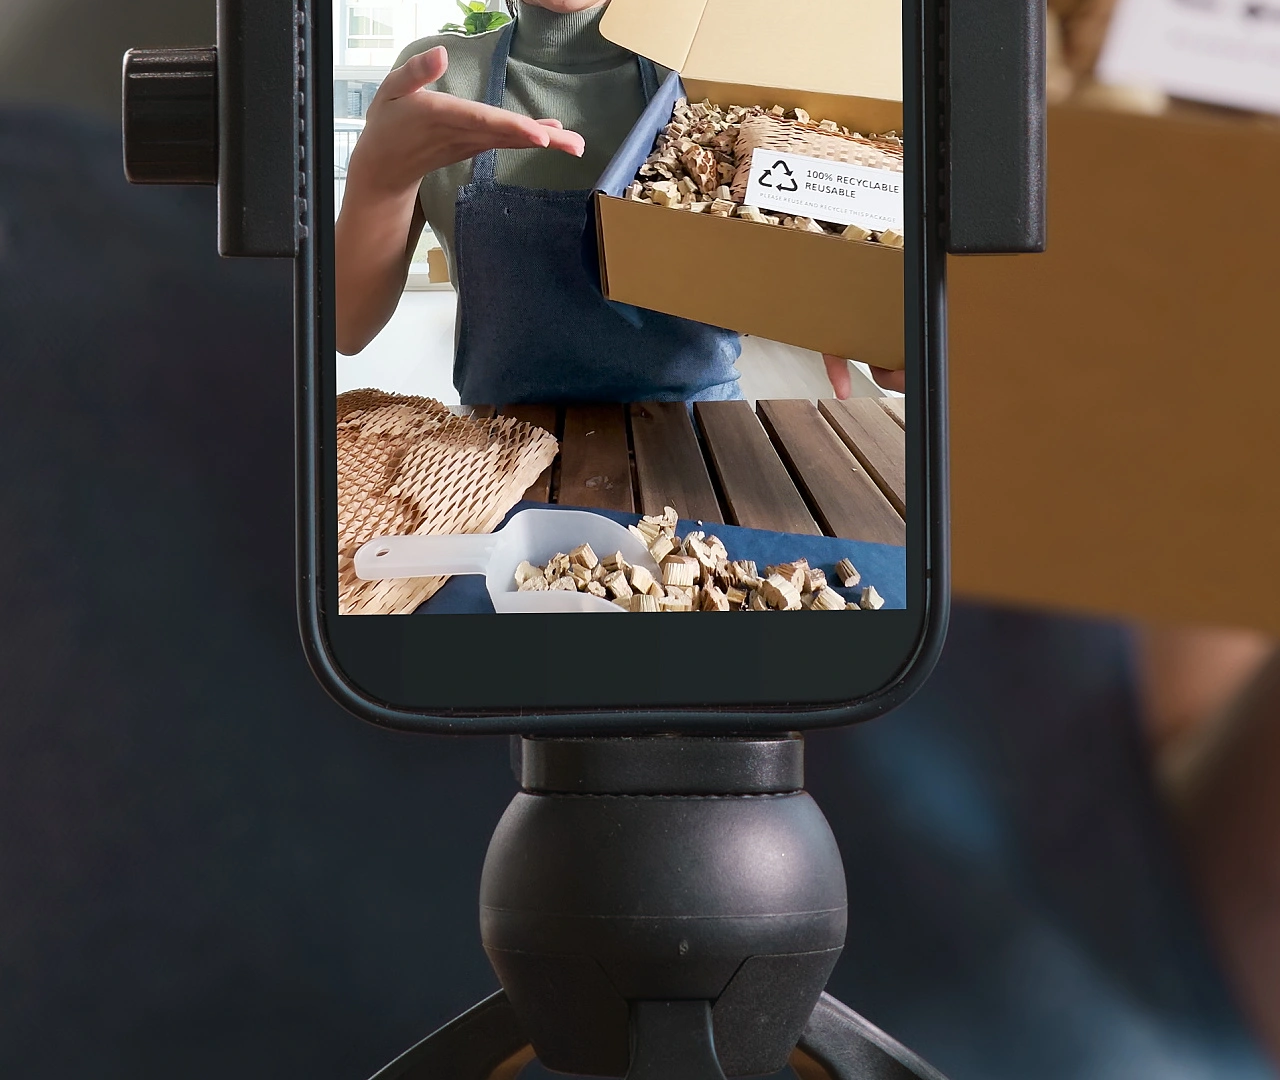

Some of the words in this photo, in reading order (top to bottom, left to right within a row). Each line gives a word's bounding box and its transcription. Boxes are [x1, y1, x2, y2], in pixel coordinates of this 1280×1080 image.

[805, 182, 856, 199] REUSABLE
[807, 170, 833, 182] 100%
[837, 175, 900, 194] RECYCLABLE
[760, 192, 782, 202] PLEASE
[804, 201, 819, 209] AND
[820, 204, 848, 214] RECYCLE
